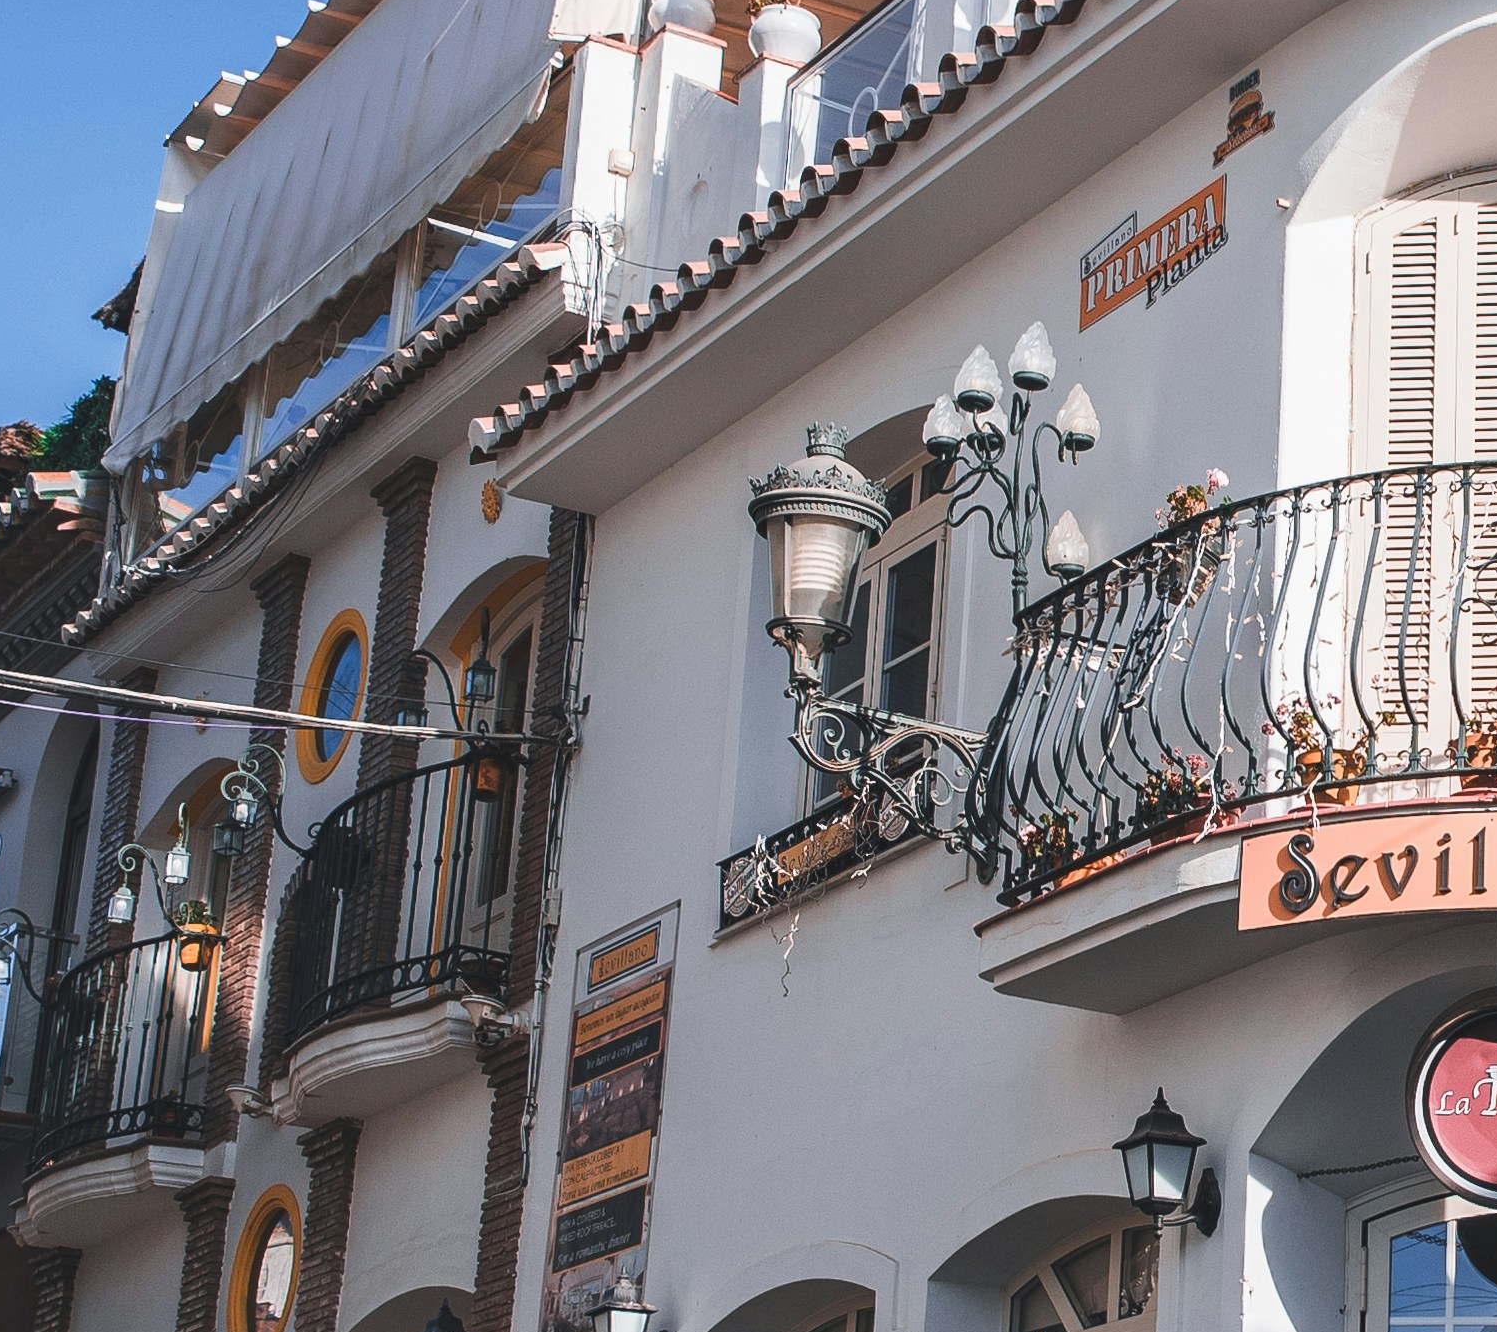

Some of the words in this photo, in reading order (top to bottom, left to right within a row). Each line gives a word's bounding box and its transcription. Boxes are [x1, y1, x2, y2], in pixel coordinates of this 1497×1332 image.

[1229, 69, 1260, 103] BURGER
[1084, 227, 1132, 275] Sevillano
[1086, 194, 1217, 312] PRIMERA
[1146, 224, 1226, 306] Planta
[599, 944, 648, 977] Sevillano
[1435, 1091, 1472, 1116] La
